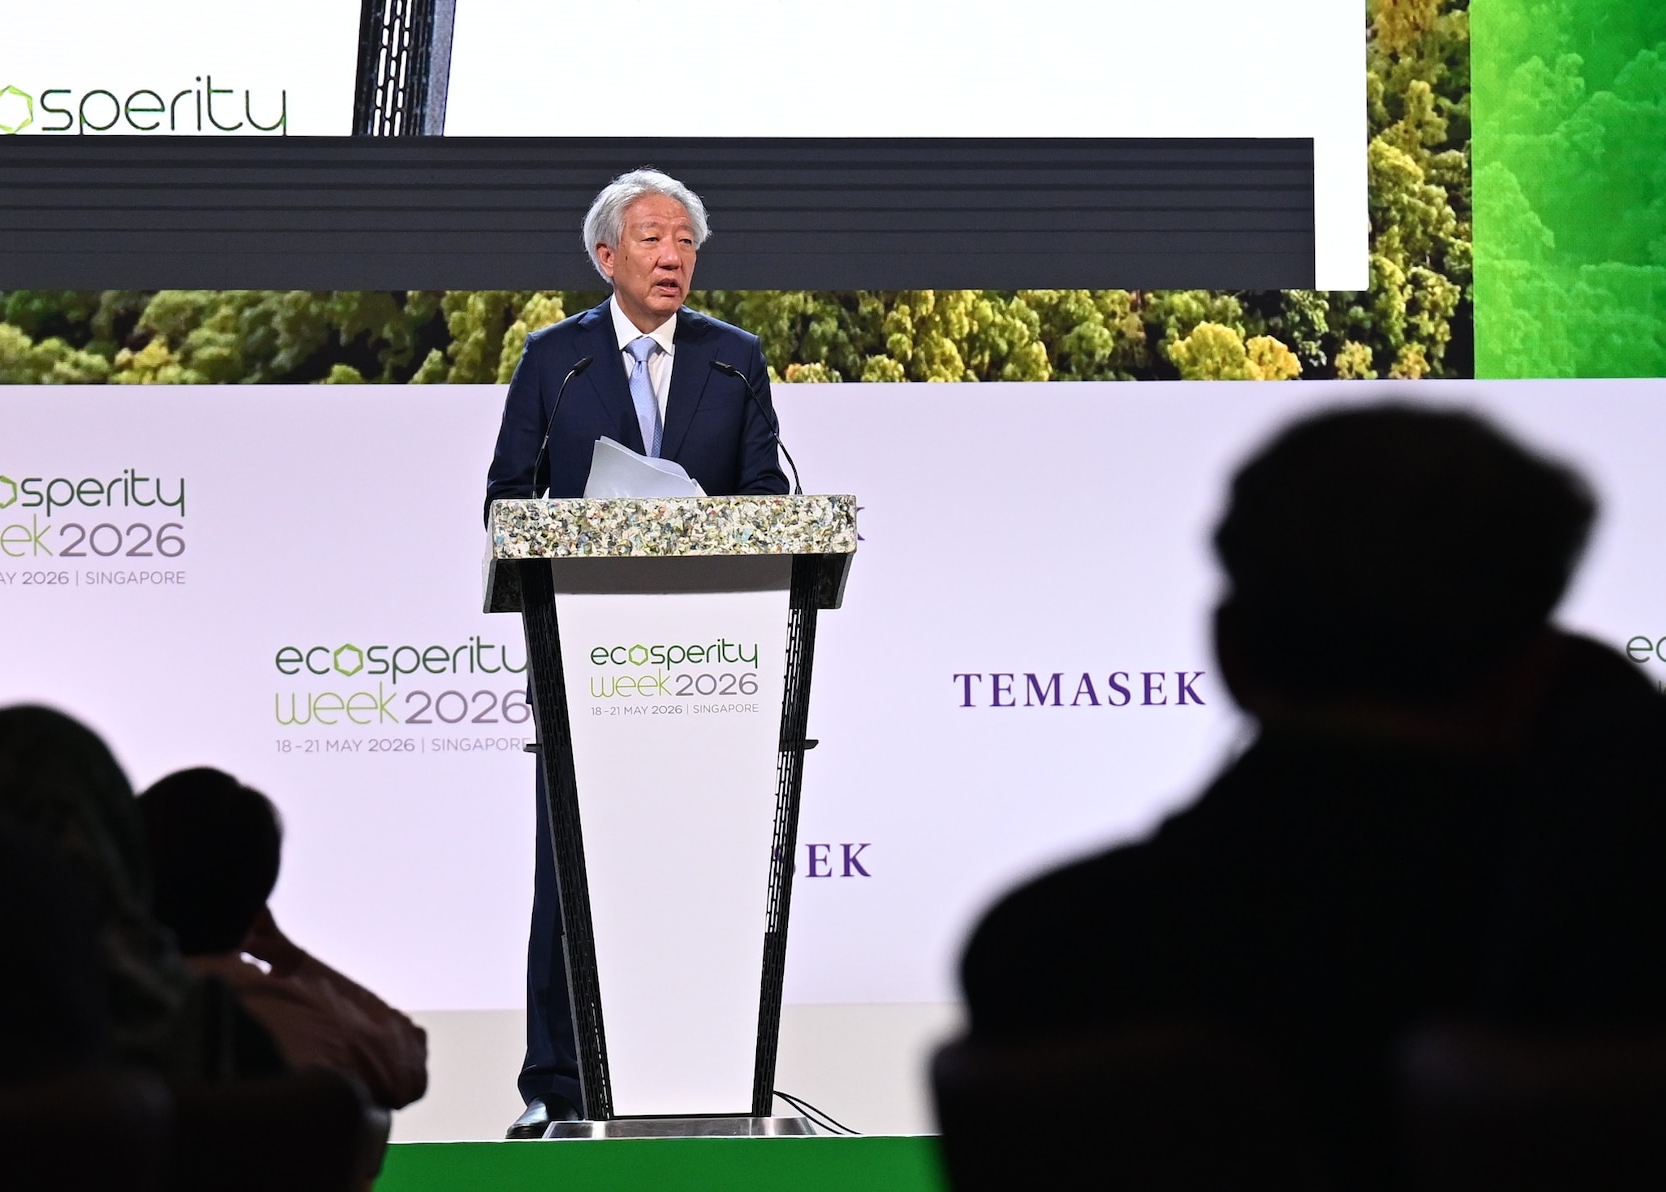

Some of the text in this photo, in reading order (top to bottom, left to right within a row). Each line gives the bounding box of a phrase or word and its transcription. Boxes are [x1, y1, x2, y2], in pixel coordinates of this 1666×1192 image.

[21, 570, 70, 586] 2026
[85, 570, 186, 586] SINGAPORE
[589, 637, 759, 672] ecosperity
[952, 670, 1207, 708] TEMASEK
[622, 705, 650, 716] MAY
[651, 704, 684, 716] 2026
[691, 703, 759, 715] SINGAPORE
[325, 739, 363, 752] MAY
[368, 737, 416, 753] 2026
